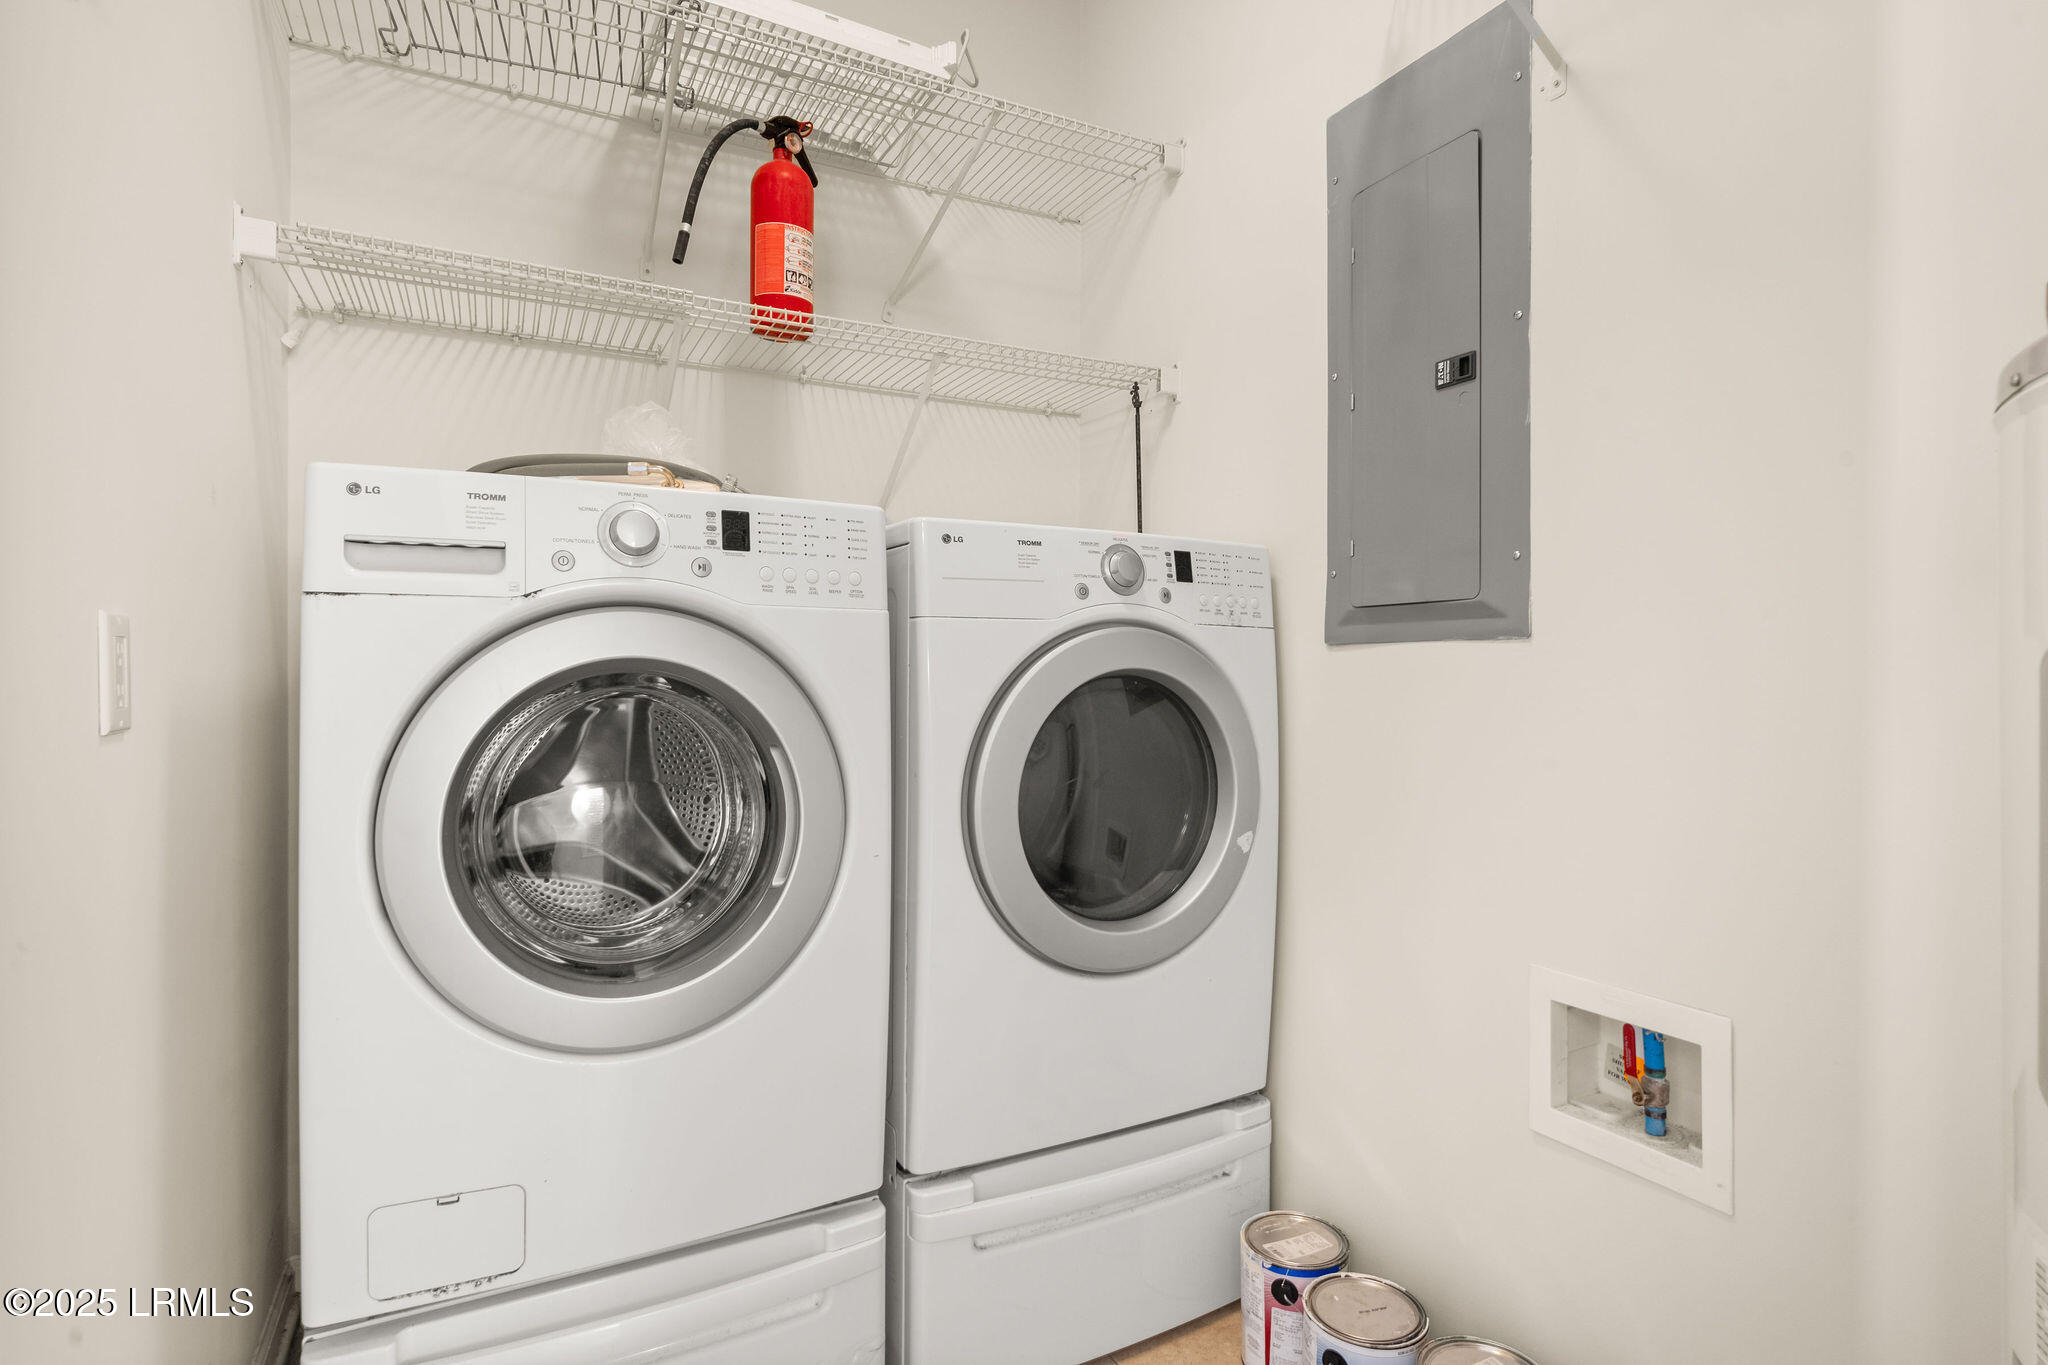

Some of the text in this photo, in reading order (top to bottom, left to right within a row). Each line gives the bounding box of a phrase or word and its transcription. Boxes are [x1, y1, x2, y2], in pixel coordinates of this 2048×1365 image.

[365, 485, 381, 495] LG
[466, 492, 506, 502] TROMM
[952, 535, 964, 544] LG
[1016, 539, 1042, 547] TROMM
